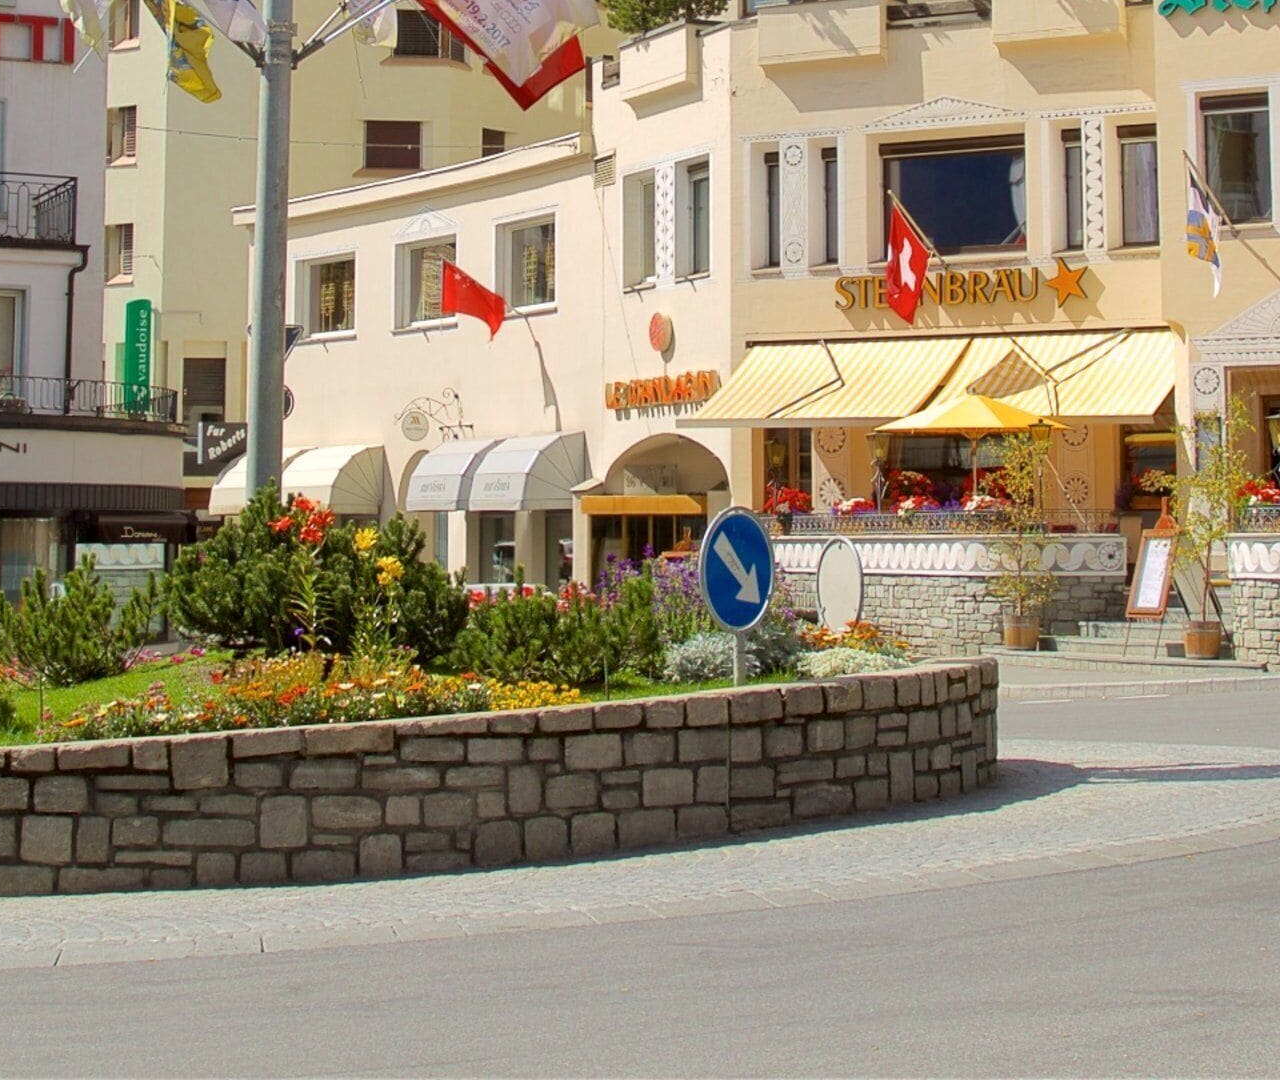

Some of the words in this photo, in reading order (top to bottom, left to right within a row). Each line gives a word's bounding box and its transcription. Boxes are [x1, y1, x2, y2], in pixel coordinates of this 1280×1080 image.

[834, 266, 1039, 311] STENBRÄU
[135, 309, 148, 382] vaudoise
[206, 424, 226, 438] Fur
[207, 427, 247, 461] Roberts
